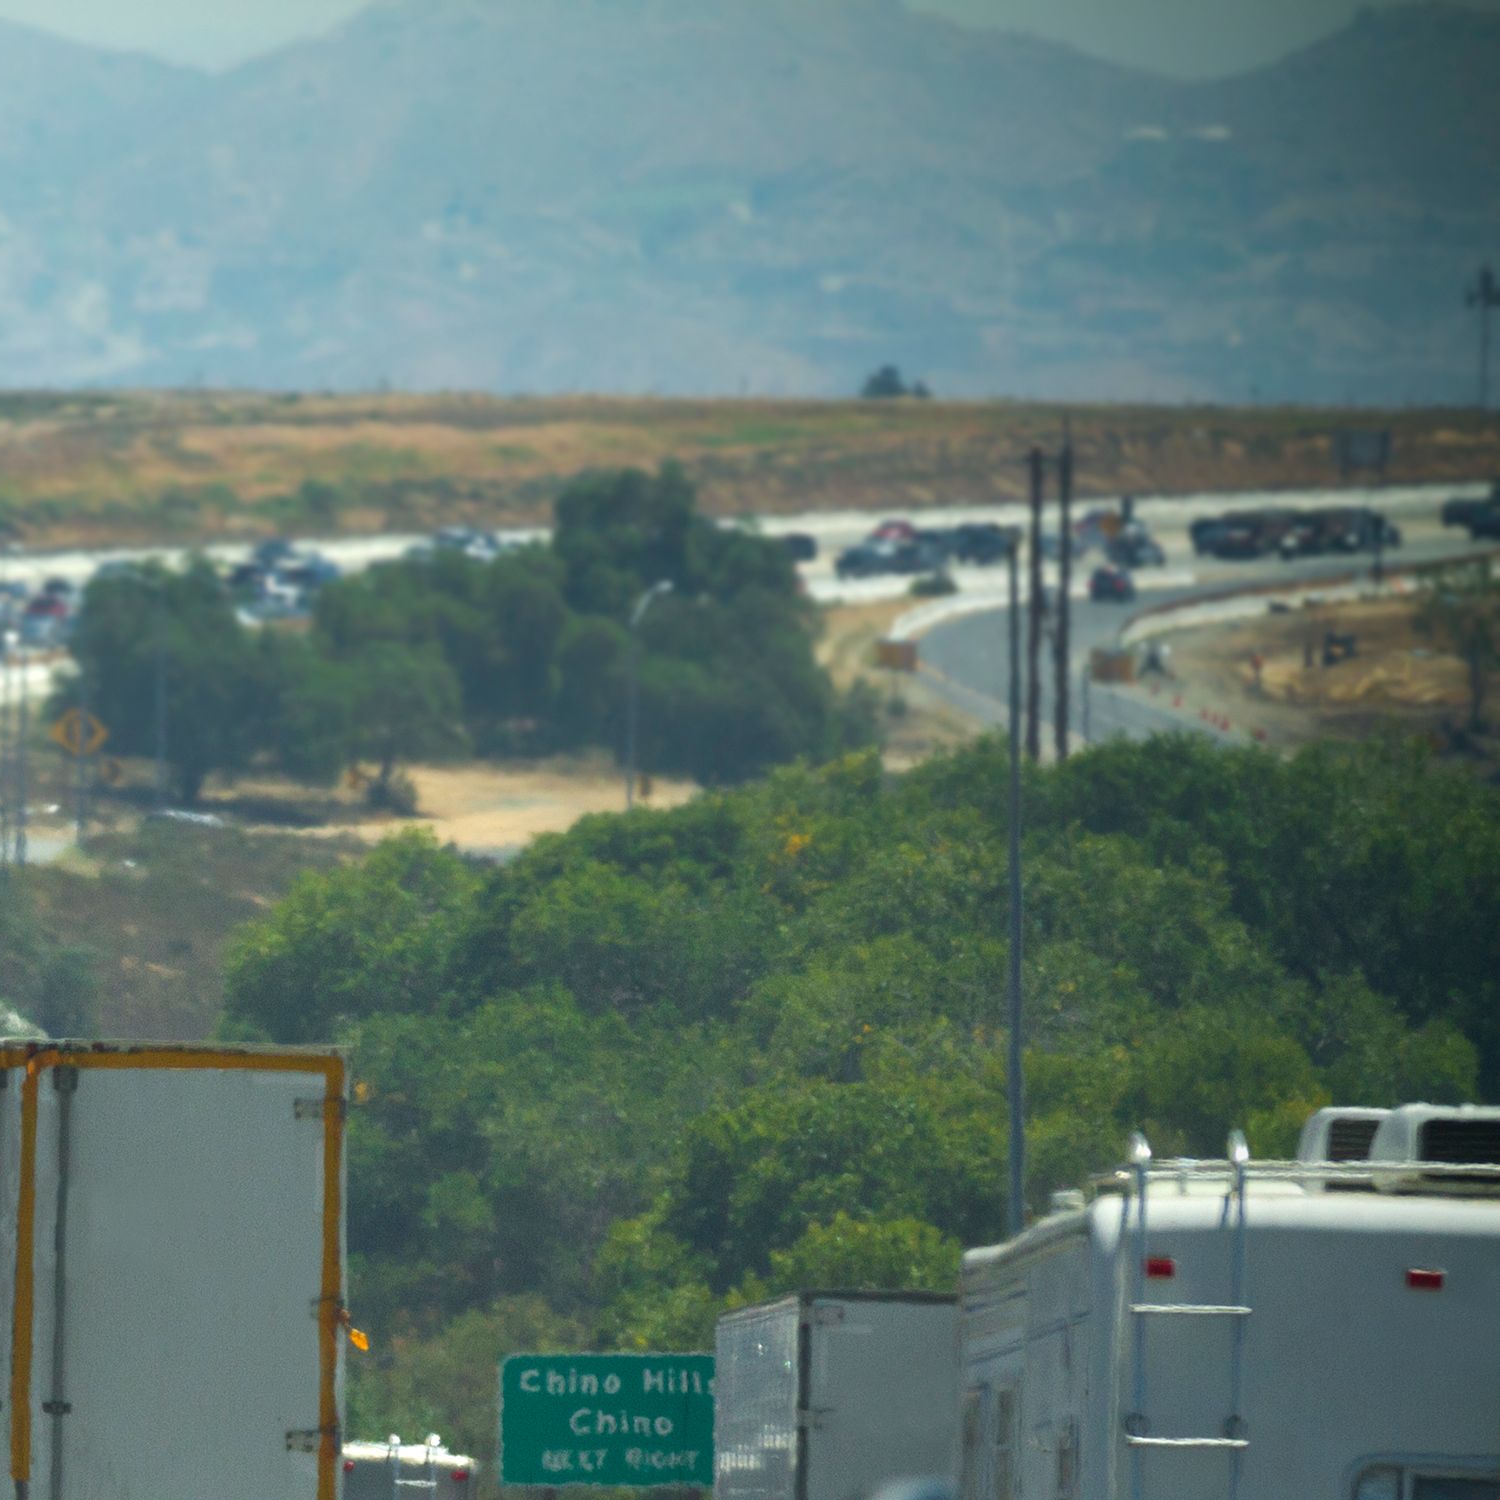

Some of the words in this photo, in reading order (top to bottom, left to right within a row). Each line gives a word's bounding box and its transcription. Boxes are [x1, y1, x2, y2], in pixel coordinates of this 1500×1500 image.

[519, 1368, 621, 1395] Chino
[569, 1407, 673, 1437] Chino
[624, 1447, 699, 1470] RIGHT
